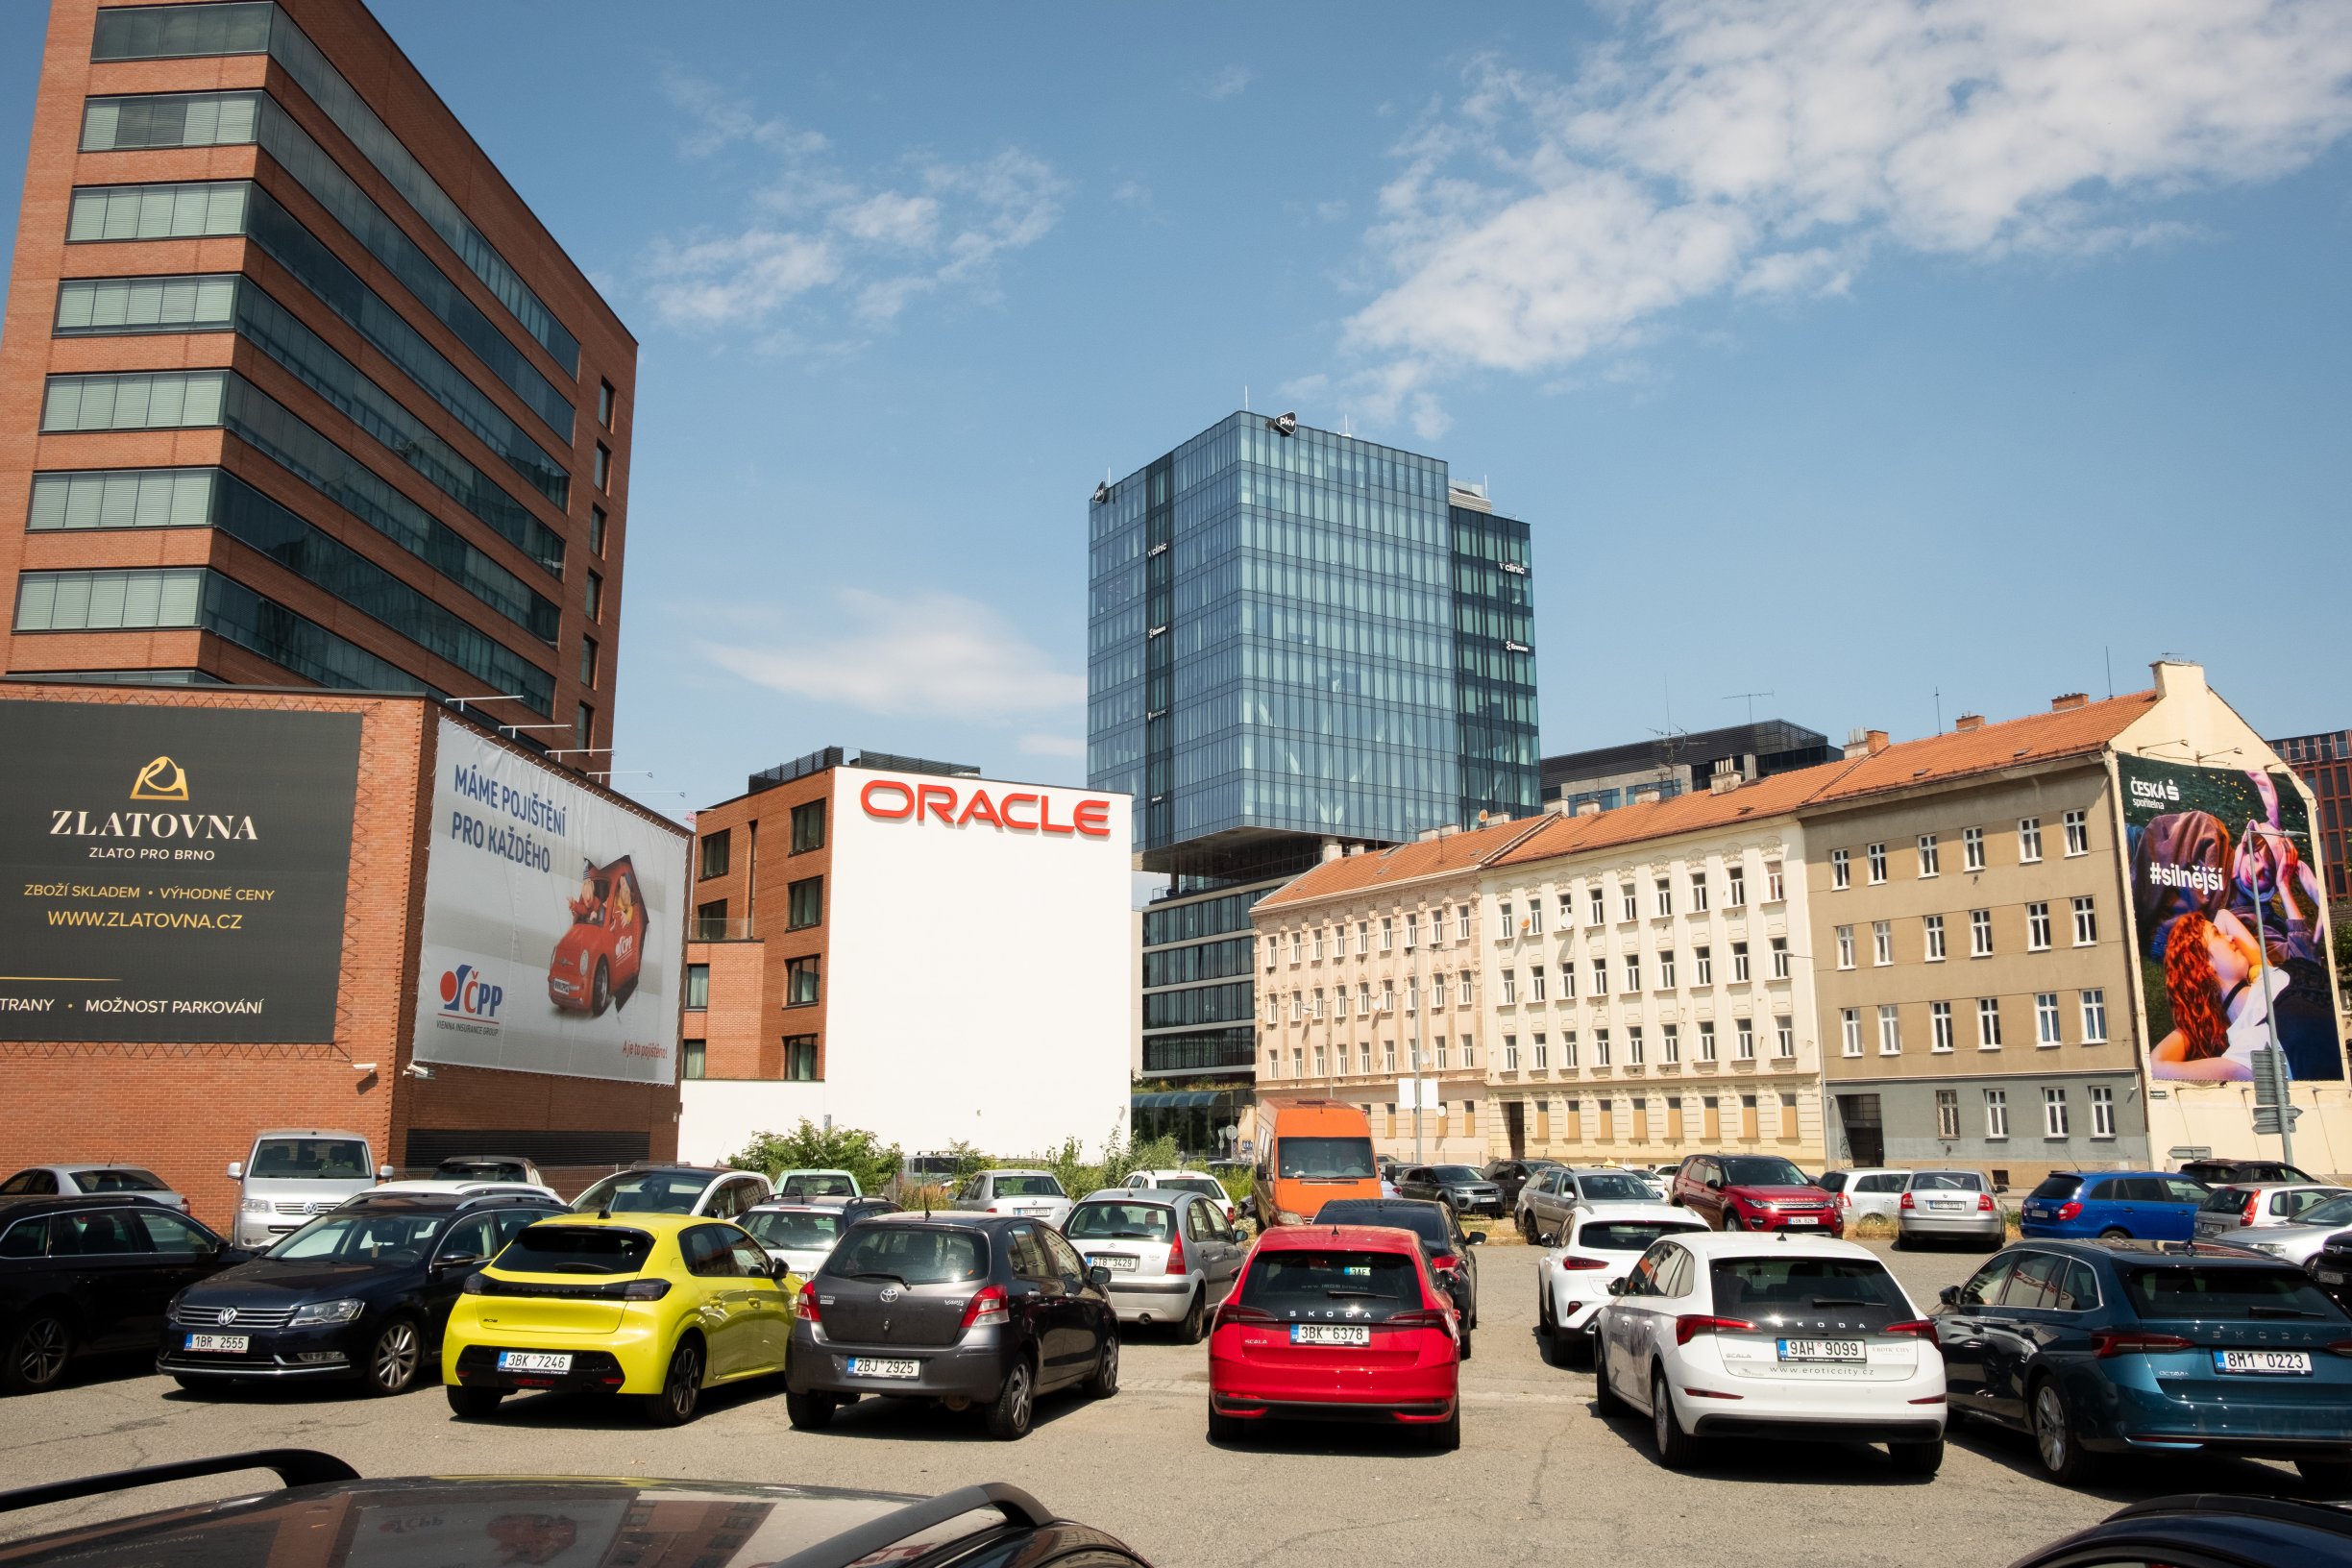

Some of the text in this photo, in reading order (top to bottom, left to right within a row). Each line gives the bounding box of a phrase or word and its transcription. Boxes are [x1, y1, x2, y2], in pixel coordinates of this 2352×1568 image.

[1280, 416, 1295, 427] pkv
[2130, 776, 2168, 799] ČESKÁ
[454, 764, 567, 838] MÁME POJIŠTĚNÍ
[860, 779, 1111, 836] ORACLE
[2133, 797, 2165, 810] spořitelna
[50, 810, 258, 841] ZLATOVNA
[452, 811, 551, 873] PRO KAŽDÉHO
[89, 847, 215, 861] ZLATO PRO BRNO
[2149, 862, 2223, 895] #silnější
[24, 882, 275, 901] ZBOŽÍ SKLADEM VÝHODNÉ CENY
[48, 910, 243, 929] WWW.ZLATOVNA.CZ
[464, 969, 502, 1017] ČPP
[86, 996, 168, 1014] MOŽNOST
[172, 998, 264, 1015] PARKOVÁNÍ
[436, 1020, 455, 1031] VIENNA
[455, 1023, 482, 1035] INSURANCE
[1113, 1258, 1133, 1267] 3429
[1301, 1326, 1323, 1339] 3BK
[1333, 1327, 1363, 1340] 6378
[195, 1335, 213, 1348] 1BR
[220, 1336, 244, 1349] 2555
[1790, 1341, 1815, 1356] 9AH
[1825, 1342, 1858, 1357] 9099
[508, 1355, 529, 1367] 3BK
[536, 1355, 565, 1368] 7246
[856, 1359, 878, 1372] 2BJ
[886, 1360, 914, 1374] 2925
[2227, 1354, 2255, 1367] 8M1
[2266, 1353, 2304, 1368] 0223
[1769, 1366, 1874, 1376] www.eroticcity.cz
